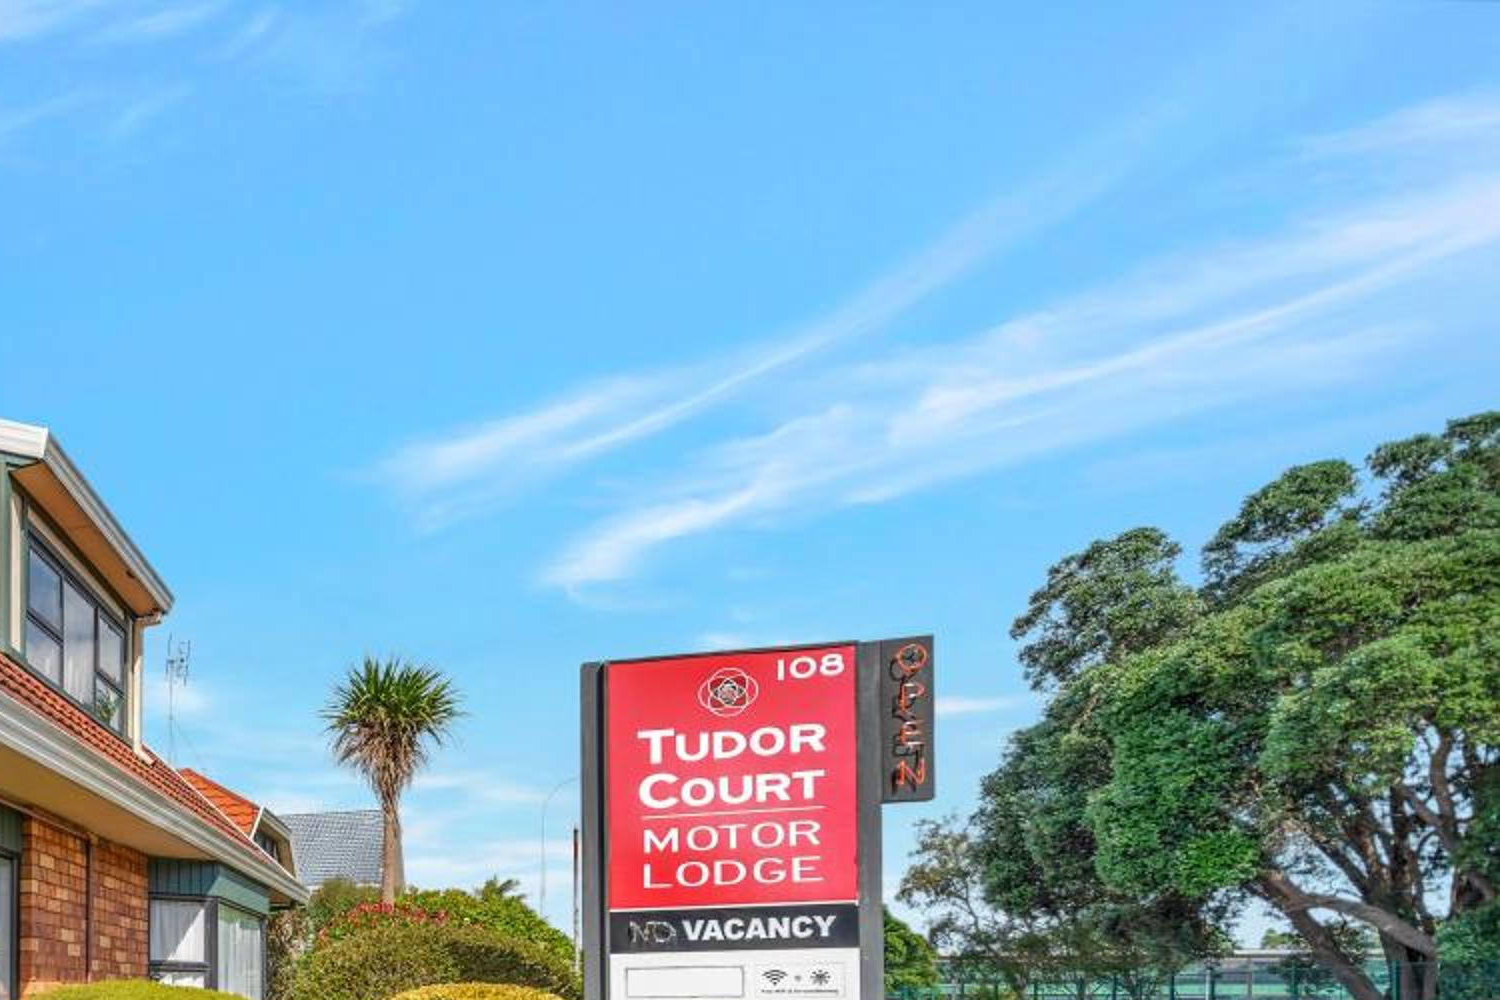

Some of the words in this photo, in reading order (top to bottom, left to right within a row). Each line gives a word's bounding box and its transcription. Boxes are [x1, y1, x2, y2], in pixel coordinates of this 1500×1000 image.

[776, 653, 844, 680] 108
[898, 642, 929, 785] OPEN
[637, 723, 826, 764] TUDOR
[638, 769, 825, 809] COURT
[643, 820, 821, 853] MOTOR
[643, 856, 824, 889] LODGE
[629, 920, 677, 943] NO
[682, 915, 836, 941] VACANCY
